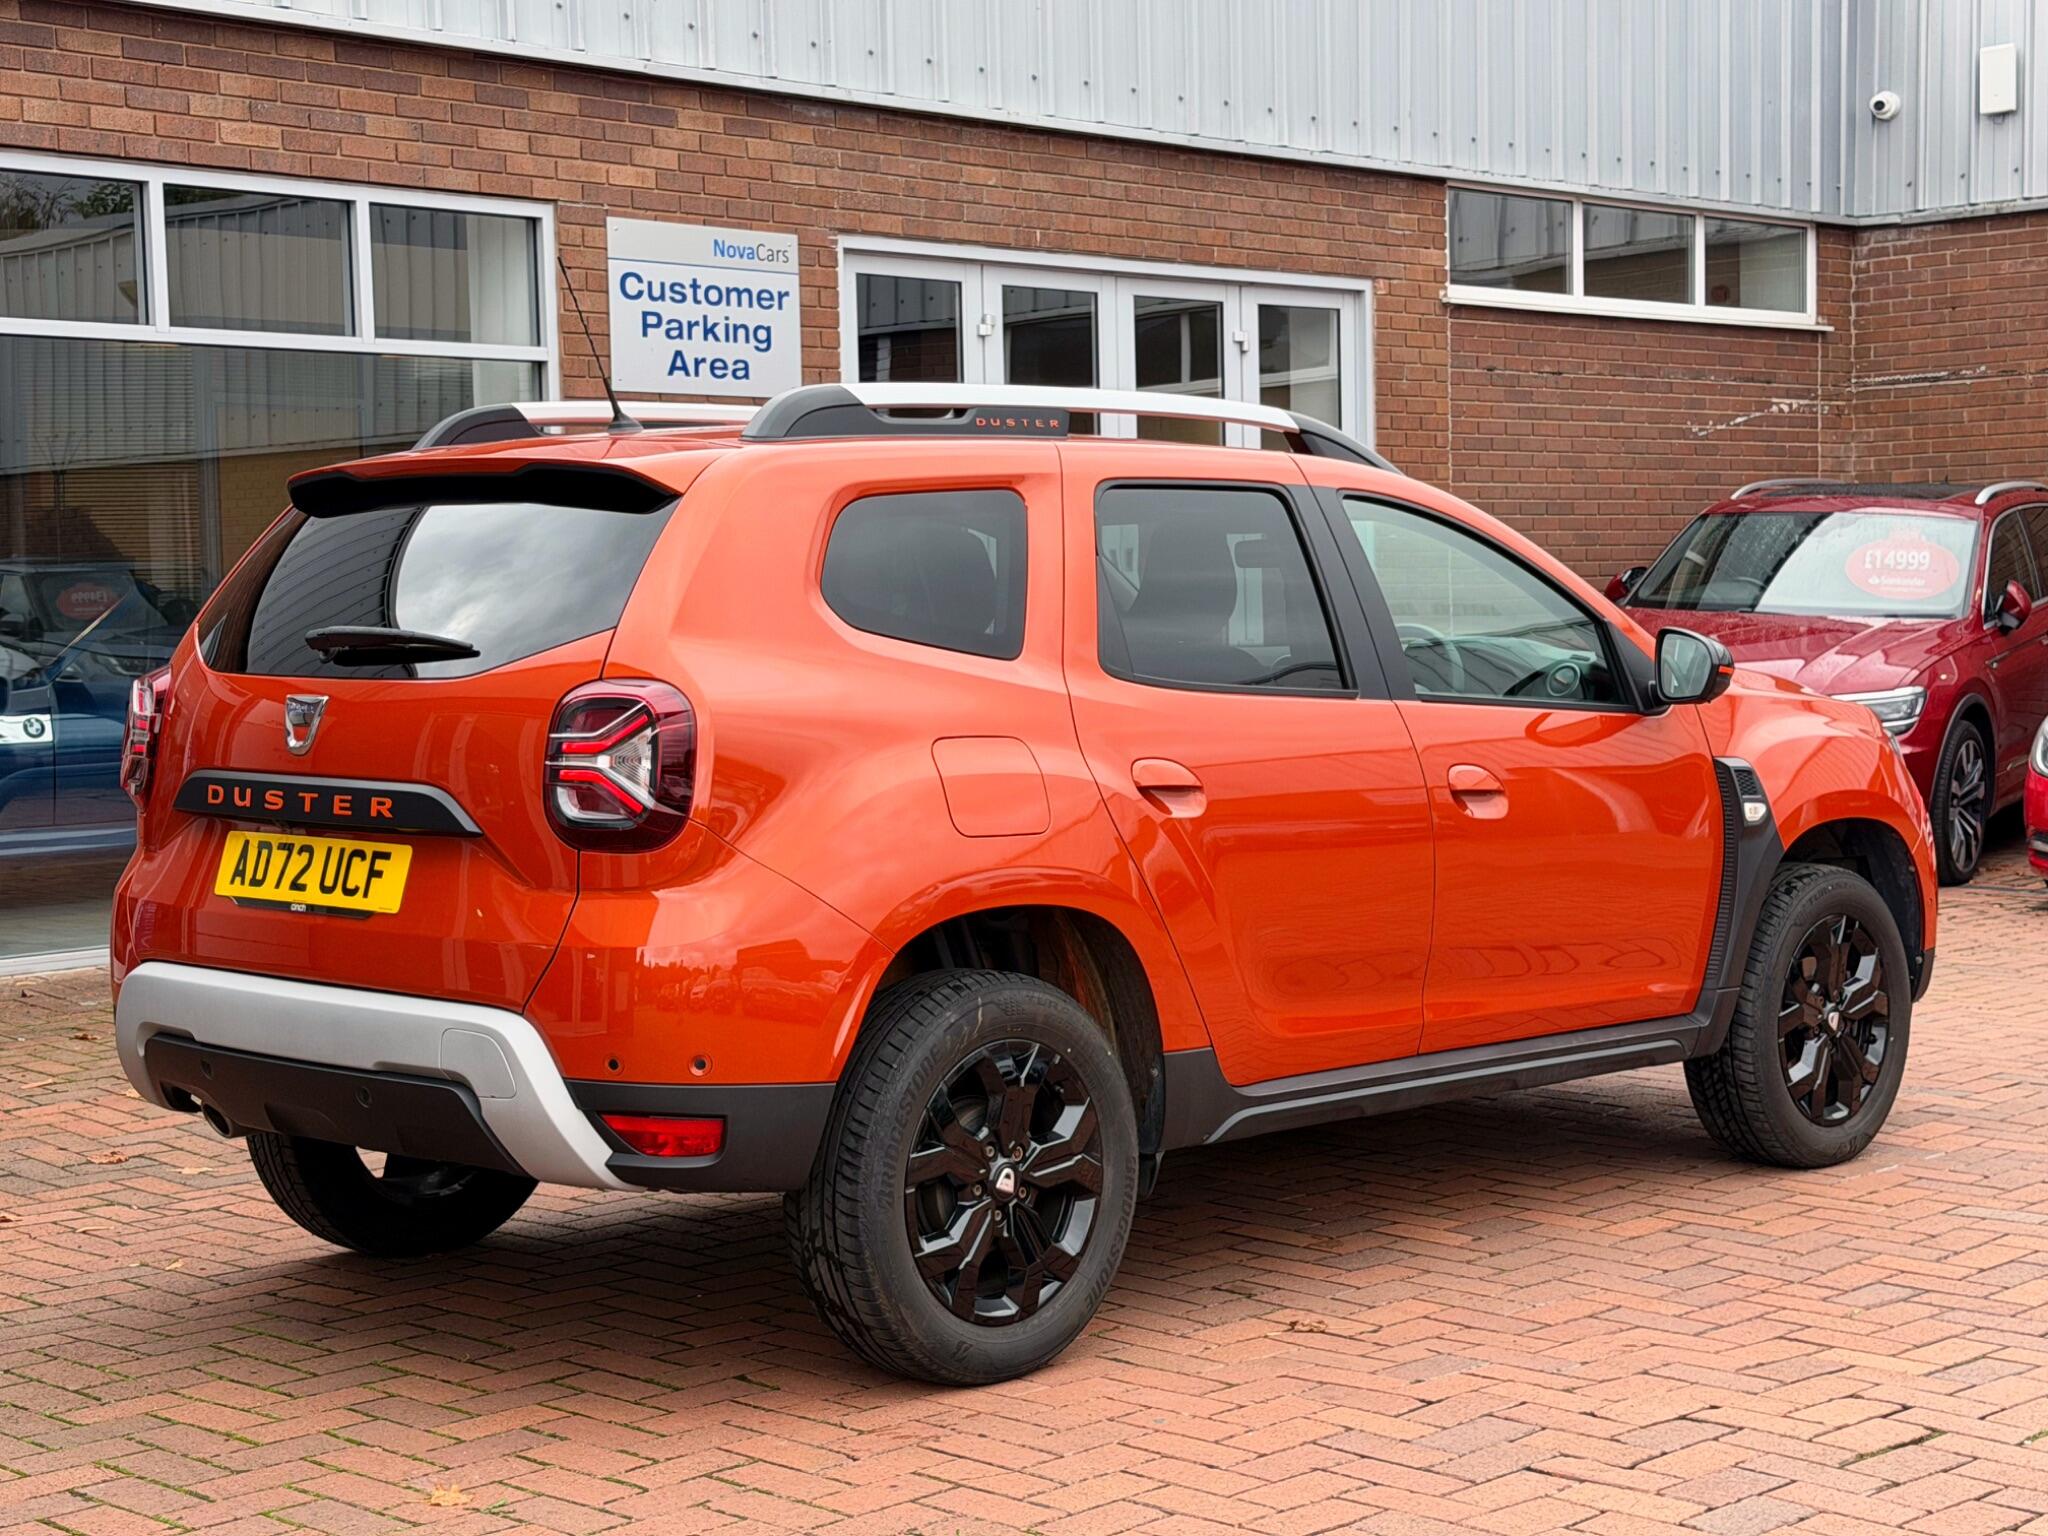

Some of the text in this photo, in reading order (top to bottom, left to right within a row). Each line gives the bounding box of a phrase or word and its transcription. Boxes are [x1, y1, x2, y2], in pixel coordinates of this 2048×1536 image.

[712, 238, 790, 264] NovaCars
[619, 271, 790, 311] Customer
[641, 310, 772, 353] Parking
[667, 349, 750, 381] Area
[975, 417, 1060, 429] DUSTER
[1864, 550, 1930, 571] £14999
[207, 784, 393, 818] DUSTER
[229, 839, 392, 899] AD72 UCF
[1085, 1155, 1137, 1311] BRIDGESTONE
